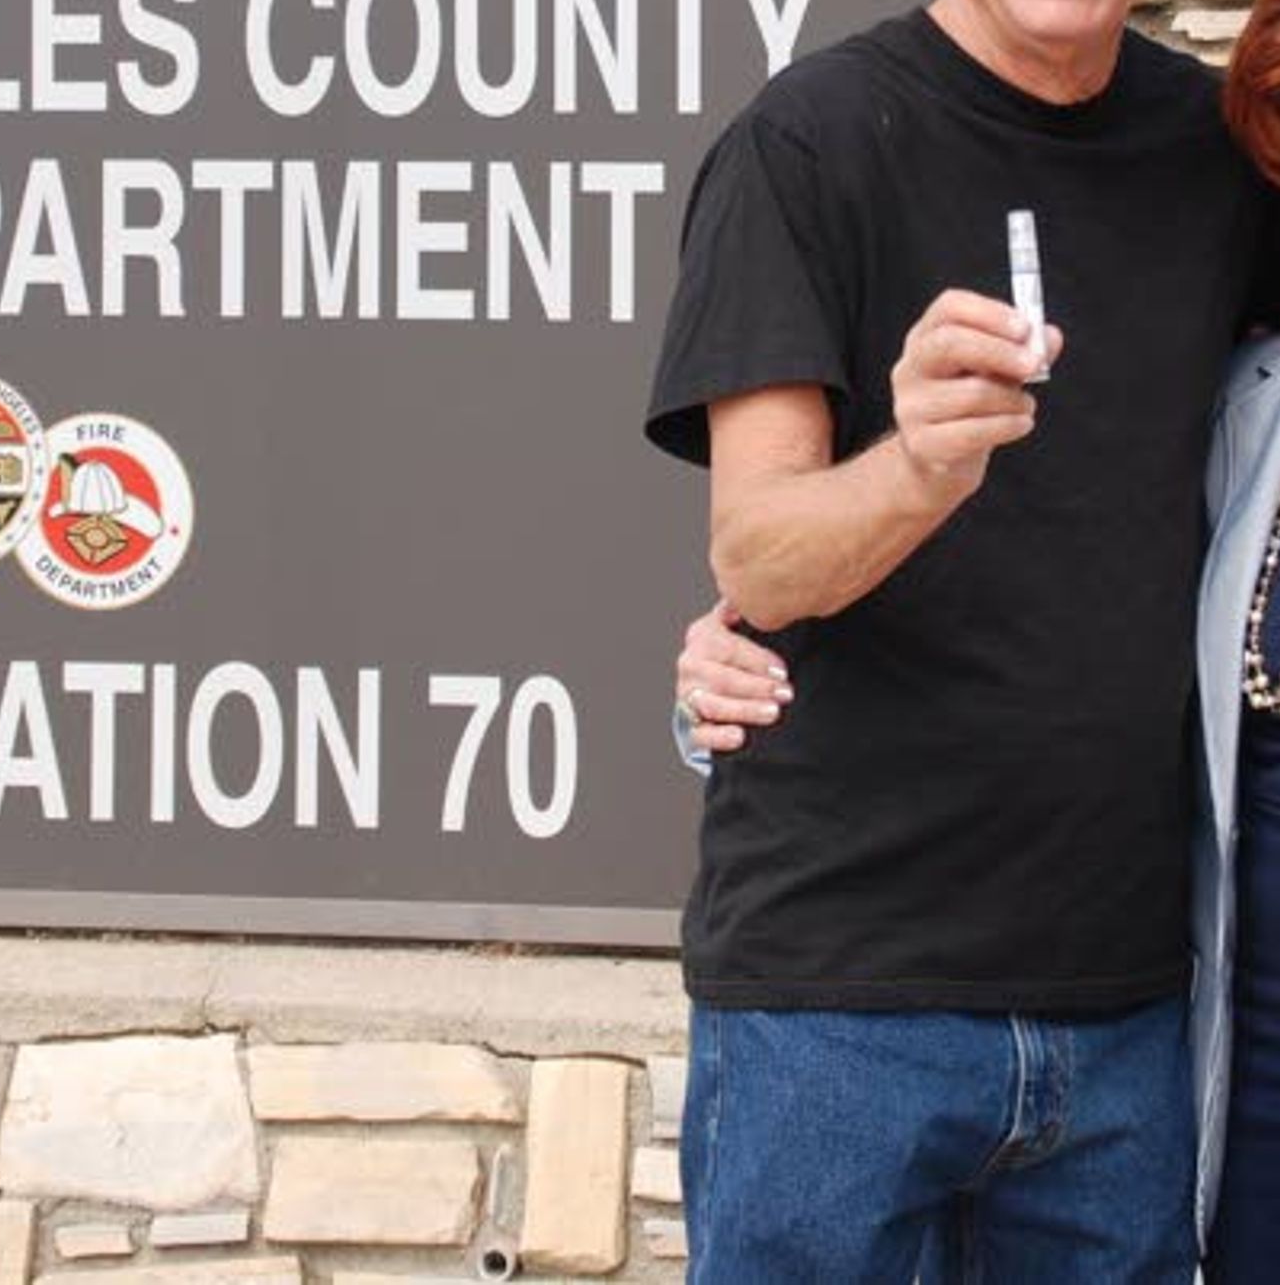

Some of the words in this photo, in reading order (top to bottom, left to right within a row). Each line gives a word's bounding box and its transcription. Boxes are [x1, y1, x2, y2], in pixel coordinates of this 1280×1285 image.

[75, 423, 127, 444] FIRE
[35, 553, 166, 601] DEPARTMENT
[430, 676, 577, 838] 70
